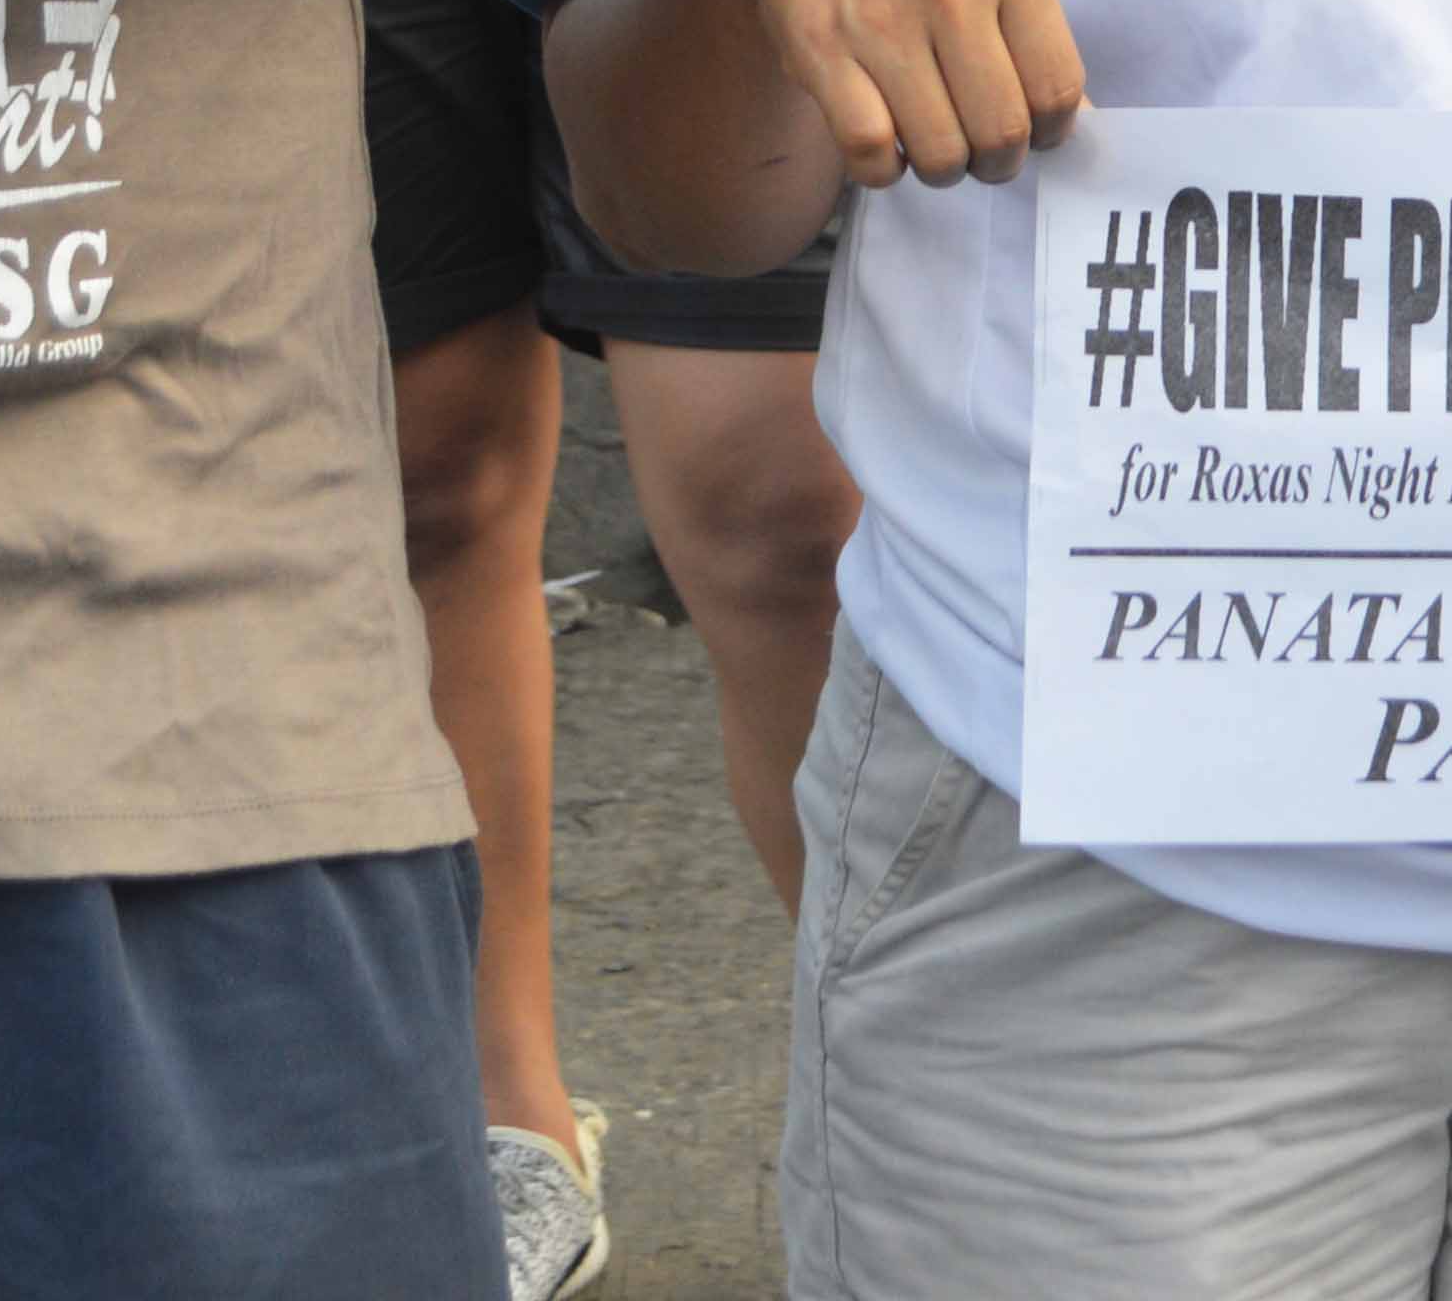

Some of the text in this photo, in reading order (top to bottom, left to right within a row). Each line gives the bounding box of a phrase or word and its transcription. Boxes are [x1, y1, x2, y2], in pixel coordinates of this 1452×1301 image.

[1085, 186, 1364, 413] #GIVE
[36, 331, 105, 365] Group
[1109, 444, 1179, 518] for
[1188, 445, 1311, 505] Roxas
[1323, 447, 1440, 522] Night
[1094, 591, 1447, 663] PANATA
